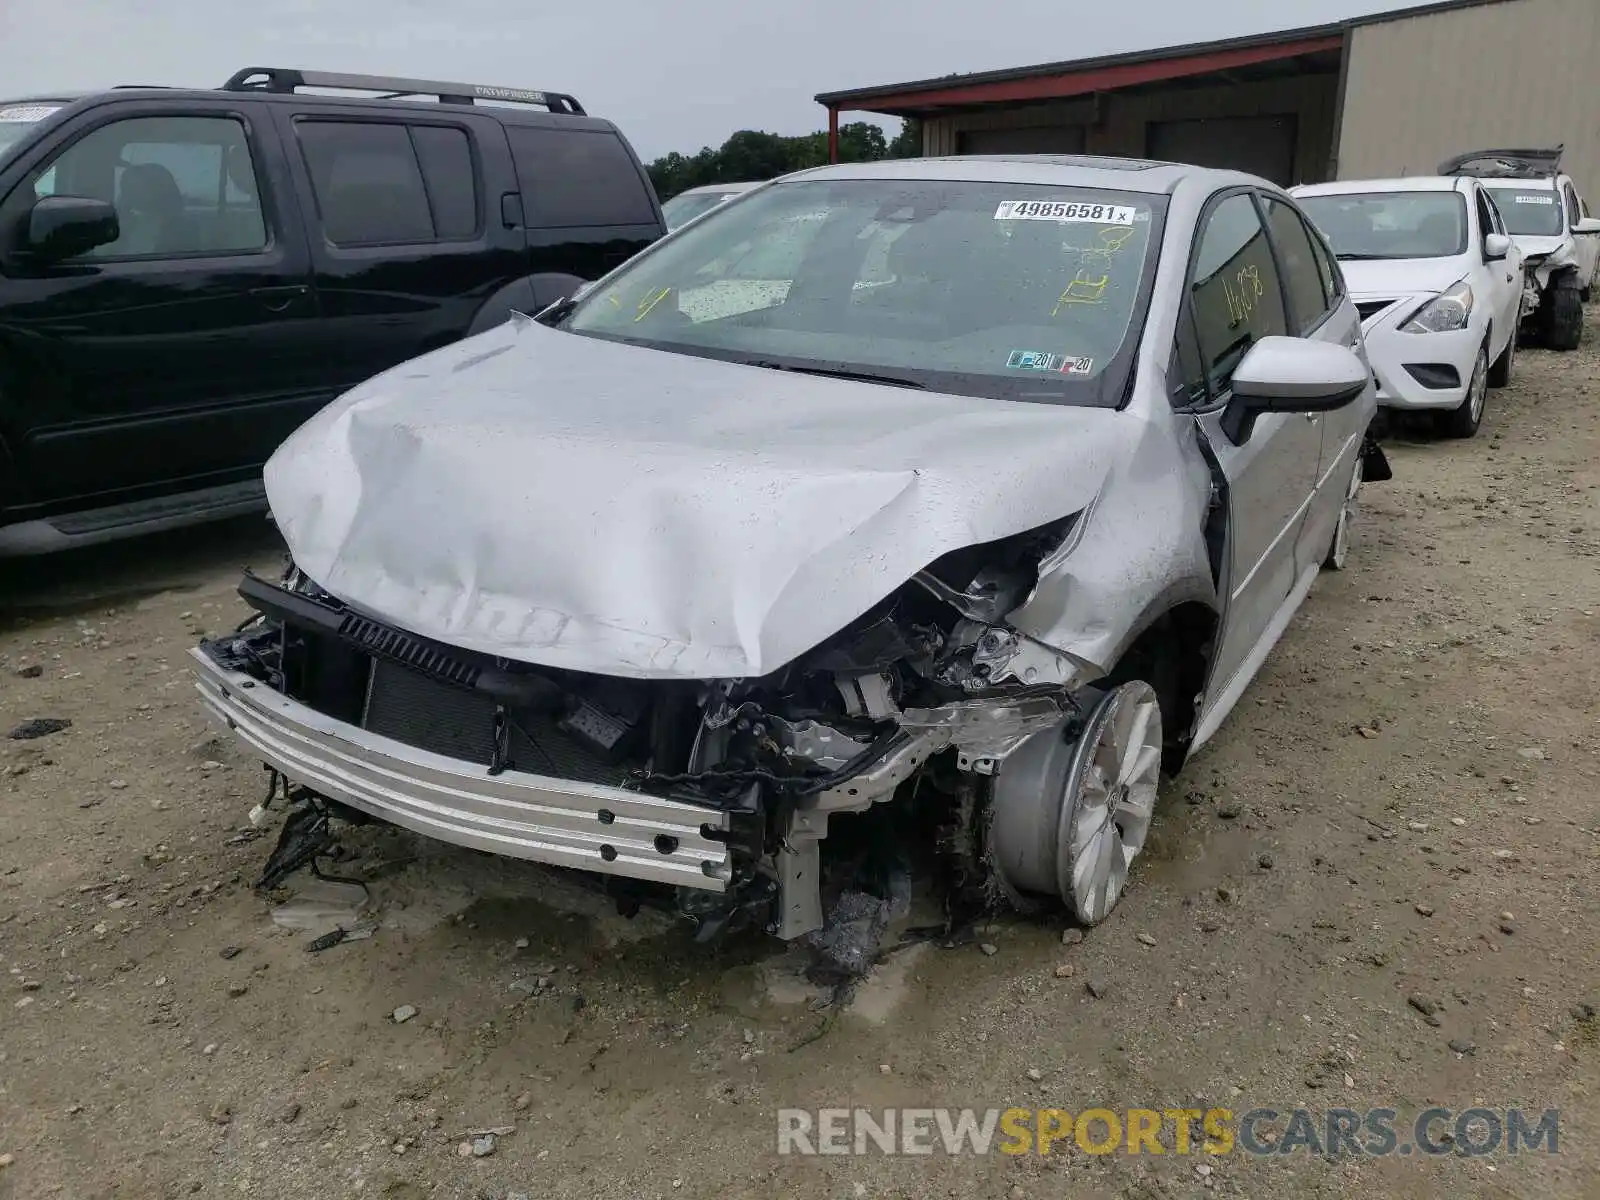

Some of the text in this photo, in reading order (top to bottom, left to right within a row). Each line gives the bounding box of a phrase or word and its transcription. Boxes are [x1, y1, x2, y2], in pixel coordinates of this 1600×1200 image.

[475, 86, 545, 101] PATHFINDER
[1014, 202, 1115, 220] 49856581
[1034, 353, 1048, 366] 20
[1076, 358, 1090, 370] 20
